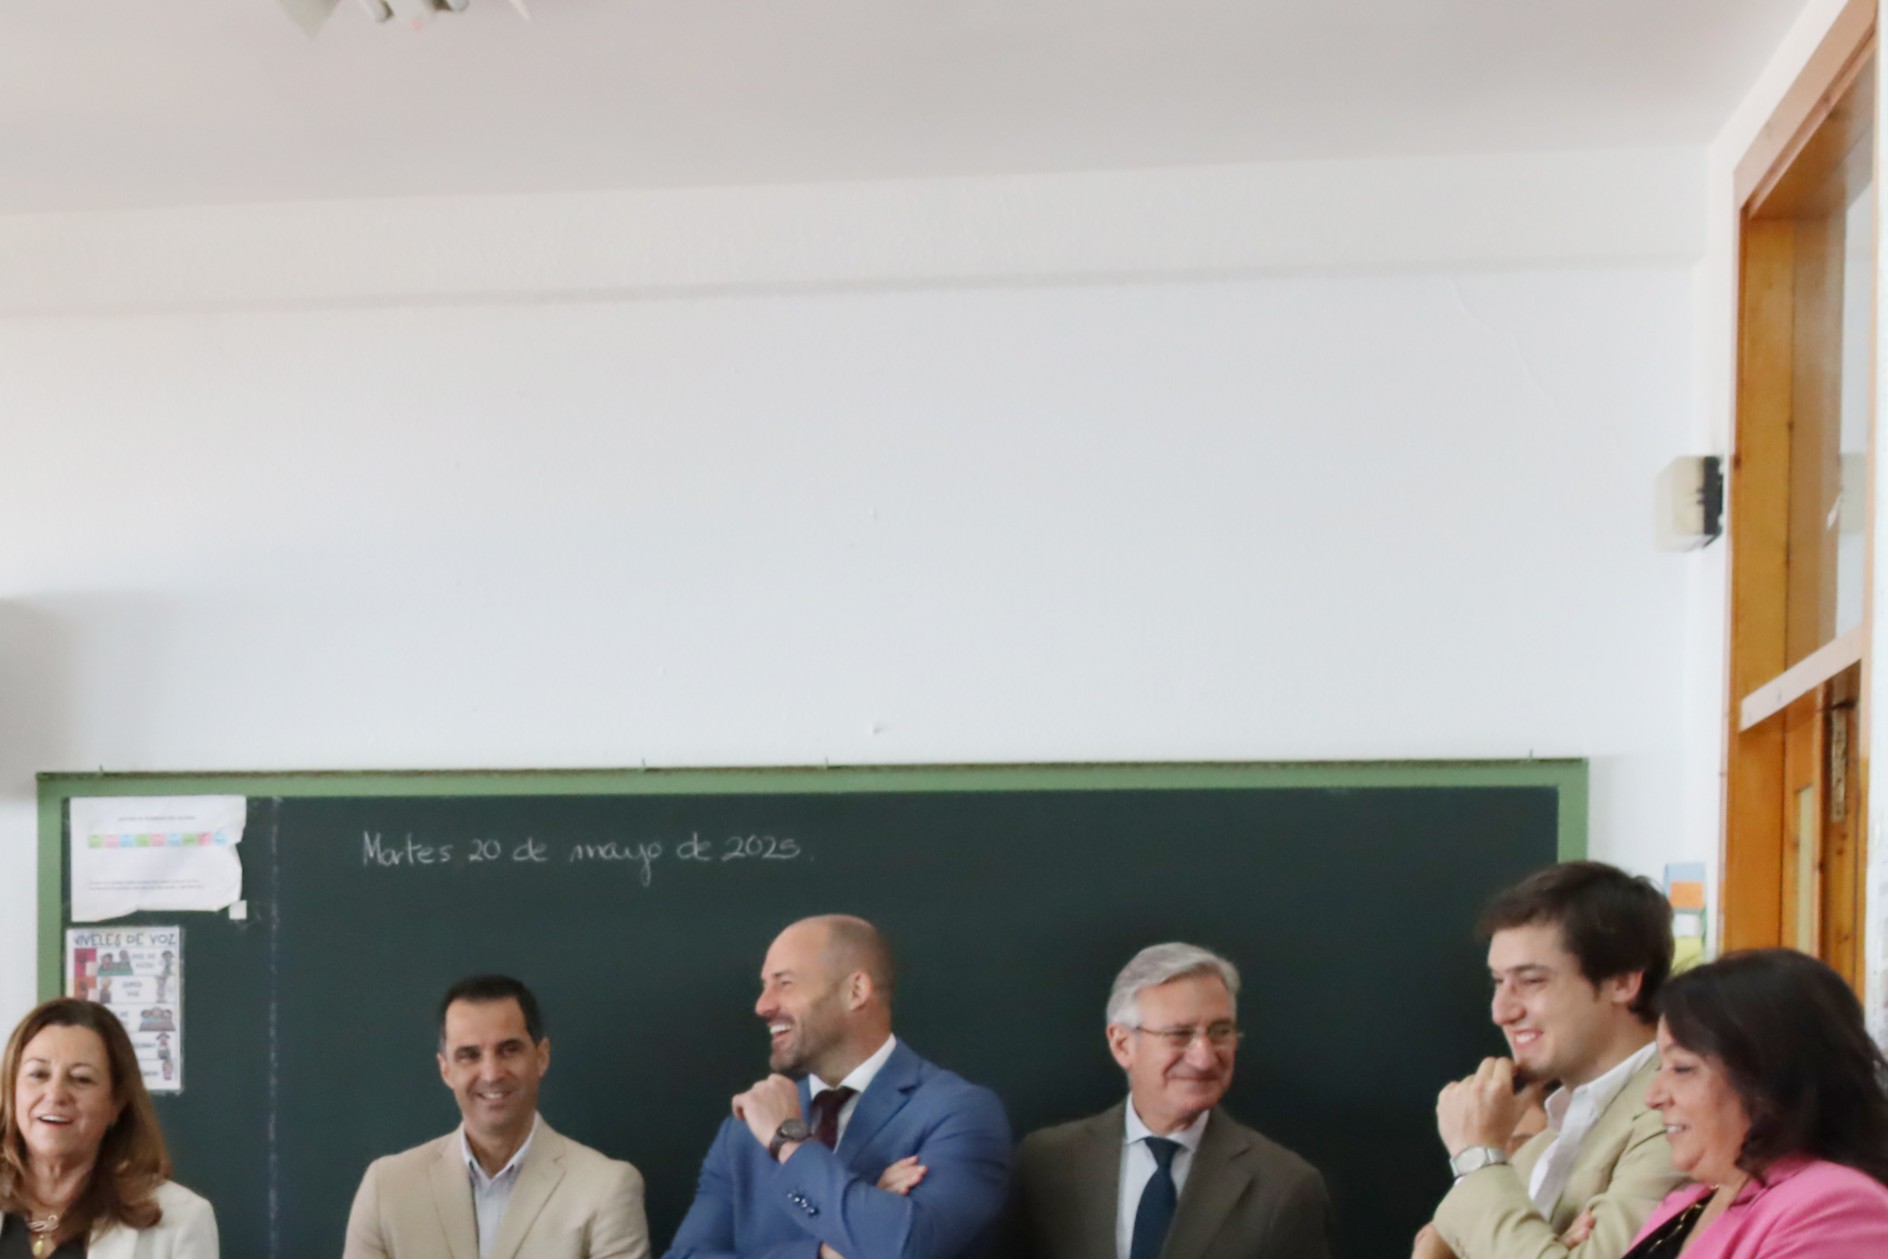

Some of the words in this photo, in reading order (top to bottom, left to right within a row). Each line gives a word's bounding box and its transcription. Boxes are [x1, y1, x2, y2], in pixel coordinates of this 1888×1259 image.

[363, 832, 454, 867] Martes
[469, 839, 501, 862] 20
[512, 836, 549, 862] de
[570, 843, 662, 887] mayo
[677, 832, 712, 862] de
